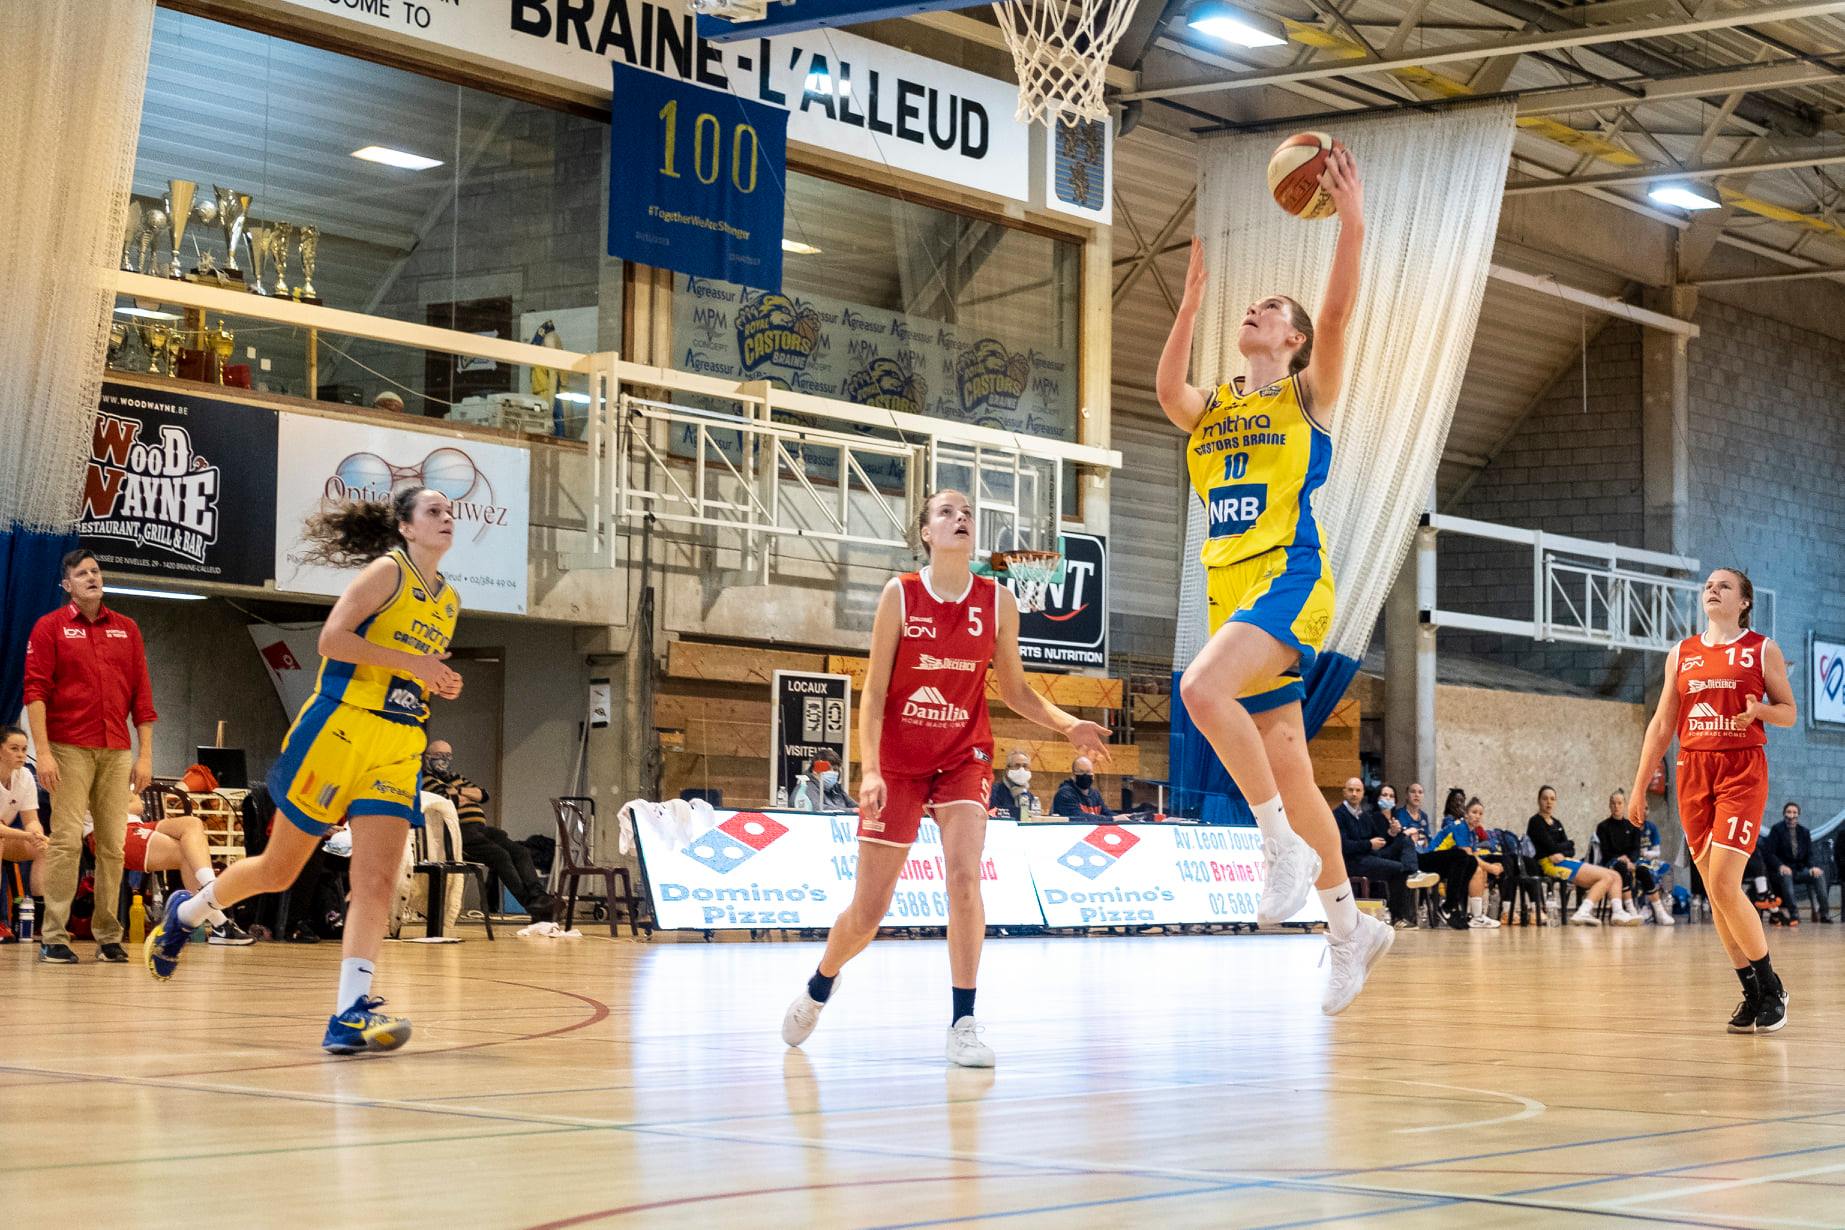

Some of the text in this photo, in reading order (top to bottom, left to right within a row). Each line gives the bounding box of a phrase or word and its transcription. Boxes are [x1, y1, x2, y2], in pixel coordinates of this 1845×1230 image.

[403, 1, 430, 28] TO
[659, 100, 758, 193] 100
[687, 276, 736, 302] Agreassur
[694, 307, 727, 329] MPM
[745, 319, 769, 336] ROYAL
[842, 308, 886, 333] Agreassur
[744, 330, 811, 366] CASTORS
[685, 348, 734, 376] Agreassur
[772, 352, 805, 368] BRAINE
[791, 372, 837, 393] Agreassur
[102, 395, 189, 415] WW.WOODWAYNE.BE
[1202, 414, 1271, 440] mithra
[1194, 433, 1286, 455] CASTORS BRAINE
[1224, 452, 1249, 481] 10
[82, 464, 214, 536] WAYNE
[325, 476, 508, 527] Opti uwez
[1210, 497, 1259, 525] NRB
[144, 523, 173, 546] GRILL
[173, 530, 182, 549] &
[183, 531, 203, 558] BAR
[968, 606, 983, 637] 5
[1020, 646, 1103, 664] RTS NUTRITION
[1725, 648, 1754, 668] 15
[788, 680, 828, 694] LOCAUX
[1688, 715, 1746, 731] Danilit
[1228, 829, 1263, 850] Joure
[1727, 816, 1753, 845] 15
[1176, 860, 1210, 882] 1420
[1210, 861, 1255, 882] Braine
[660, 882, 828, 902] Domino's
[1044, 886, 1176, 905] Domino's
[702, 906, 800, 924] Pizza
[896, 891, 931, 918] 588
[1080, 907, 1155, 923] Pizza
[1209, 893, 1227, 915] 02
[1228, 893, 1255, 915] 588
